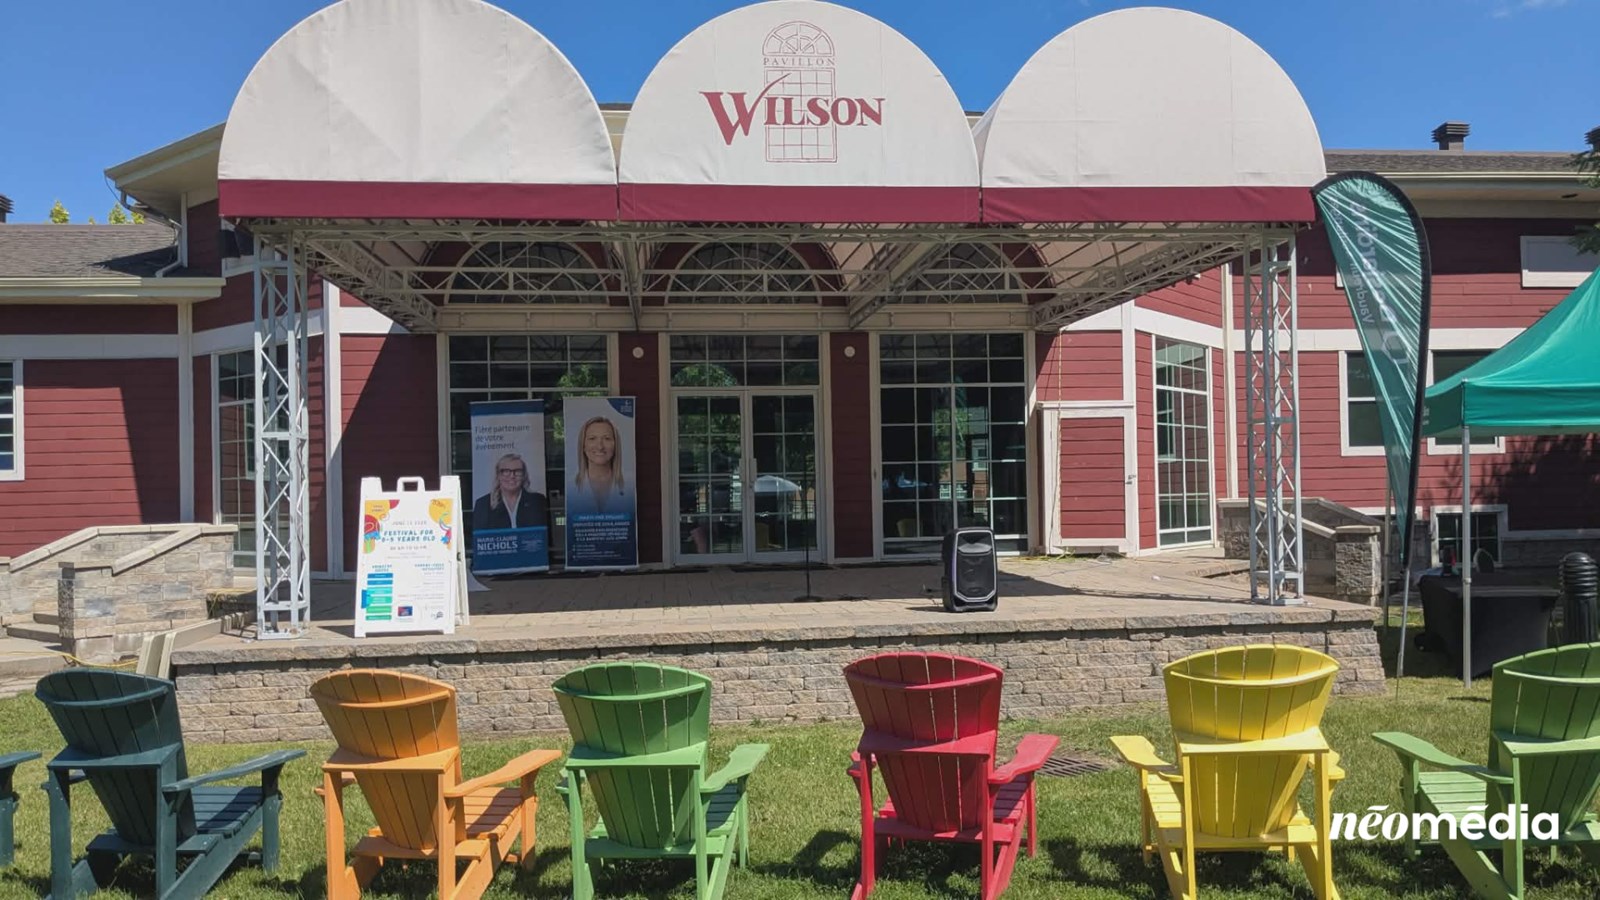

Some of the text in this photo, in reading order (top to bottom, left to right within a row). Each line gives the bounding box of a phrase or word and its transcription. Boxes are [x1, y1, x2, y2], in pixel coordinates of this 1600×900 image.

[762, 57, 836, 66] PAVILLON
[699, 72, 886, 146] WILSON
[383, 529, 418, 537] FESTIVAL
[476, 541, 518, 551] NICHOLS
